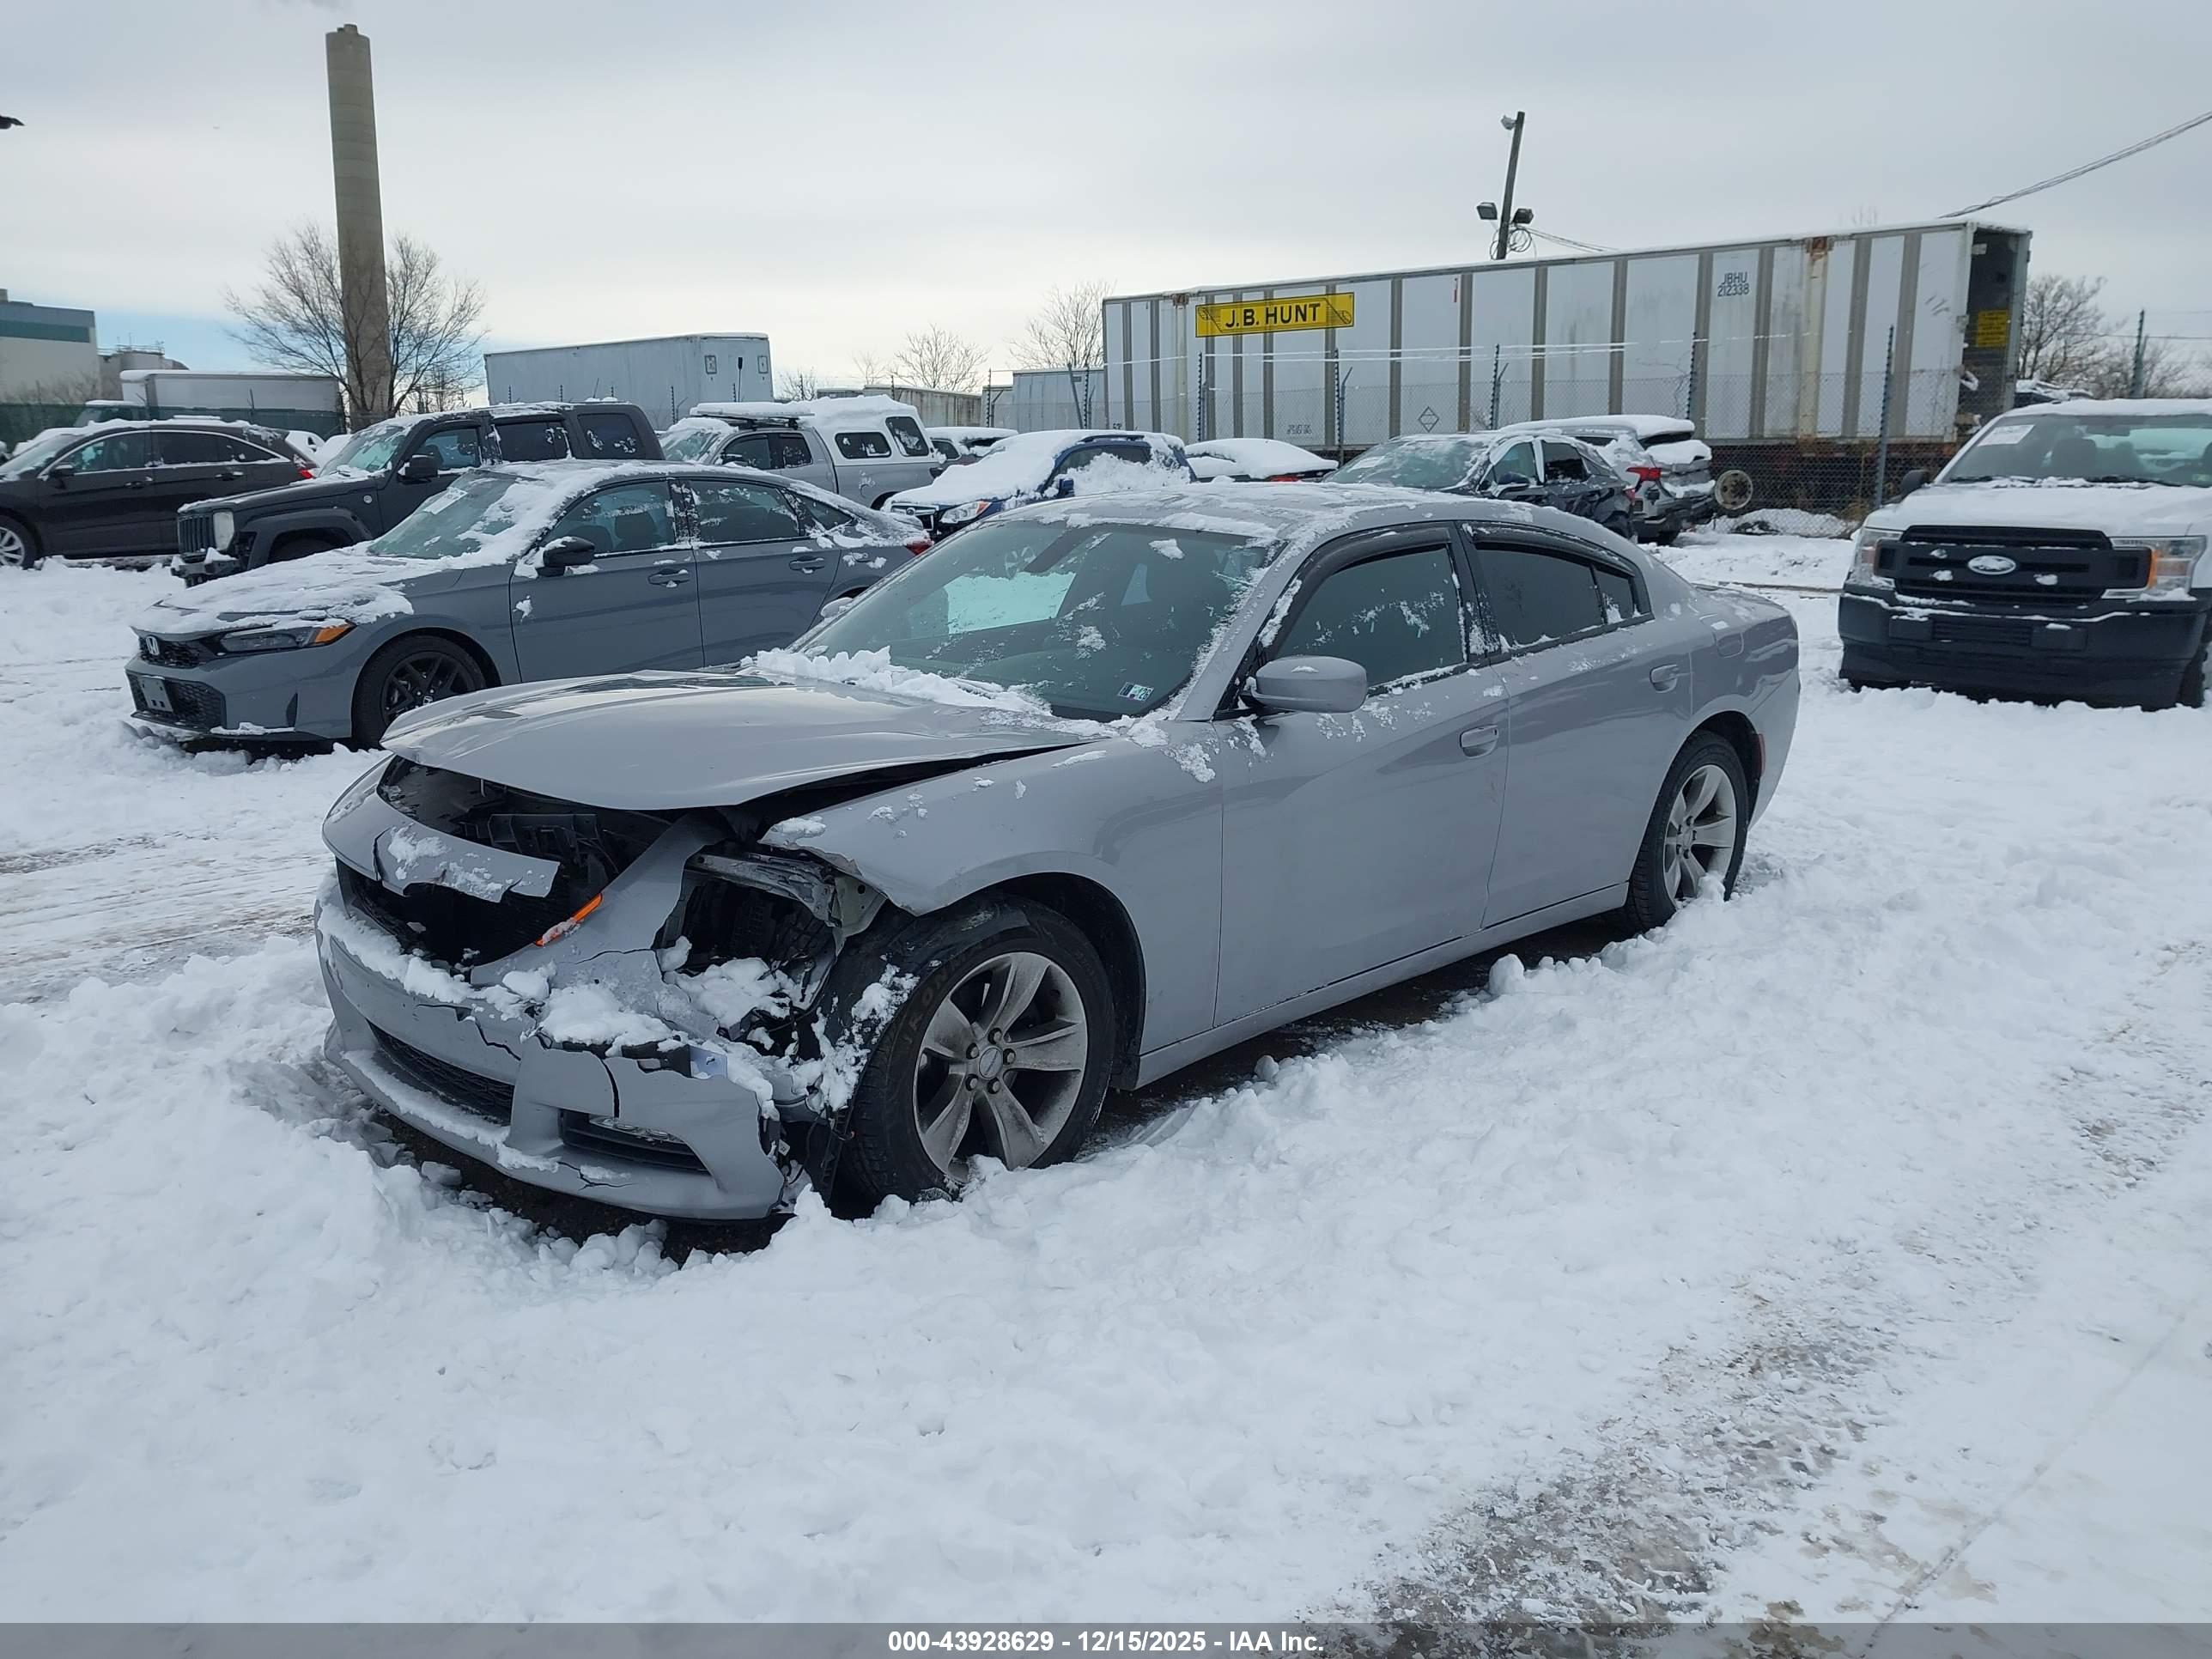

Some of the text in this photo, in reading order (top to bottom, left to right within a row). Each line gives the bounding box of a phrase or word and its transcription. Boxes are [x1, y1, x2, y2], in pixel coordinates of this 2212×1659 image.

[1722, 271, 1747, 284] JBHU
[1717, 283, 1749, 297] 212338
[1225, 303, 1320, 327] J.B. HUNT
